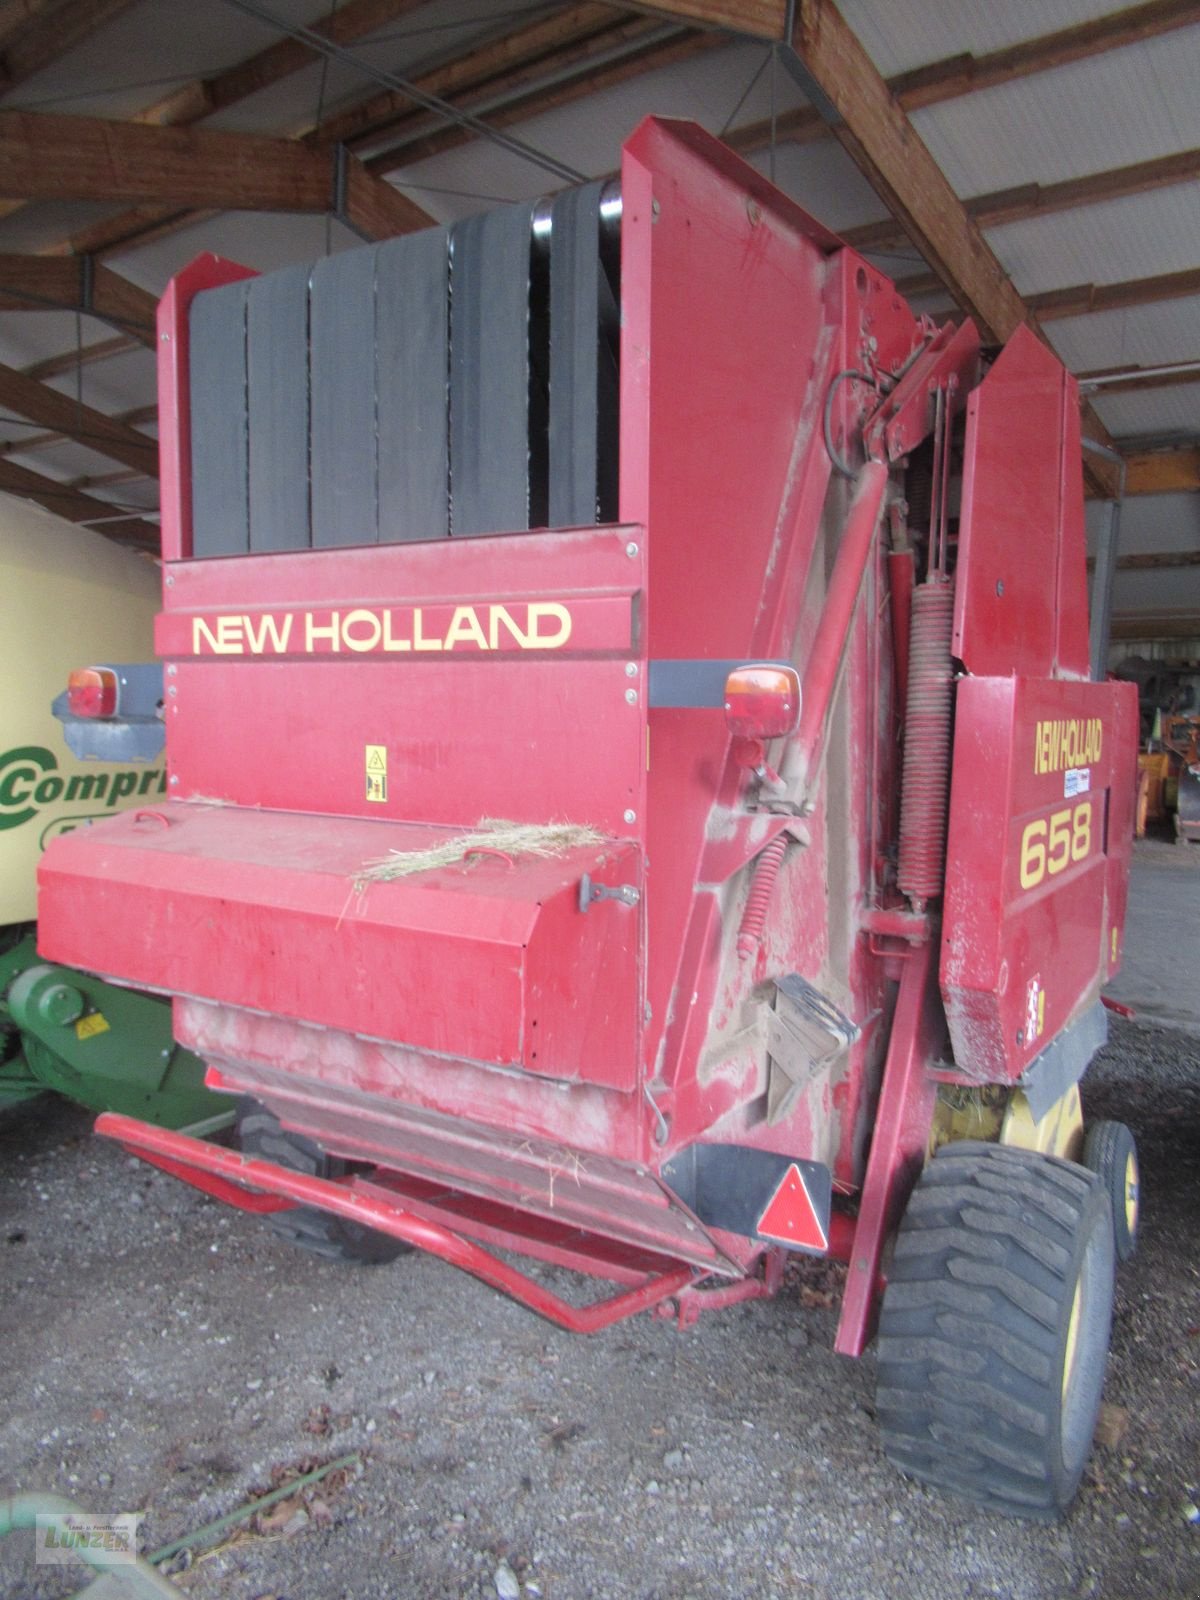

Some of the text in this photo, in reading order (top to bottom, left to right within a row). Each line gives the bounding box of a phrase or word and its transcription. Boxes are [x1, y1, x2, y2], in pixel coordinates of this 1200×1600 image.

[193, 603, 572, 654] NEW HOLLAND
[1034, 717, 1103, 776] NEW HOLLAND
[1020, 802, 1092, 890] 658
